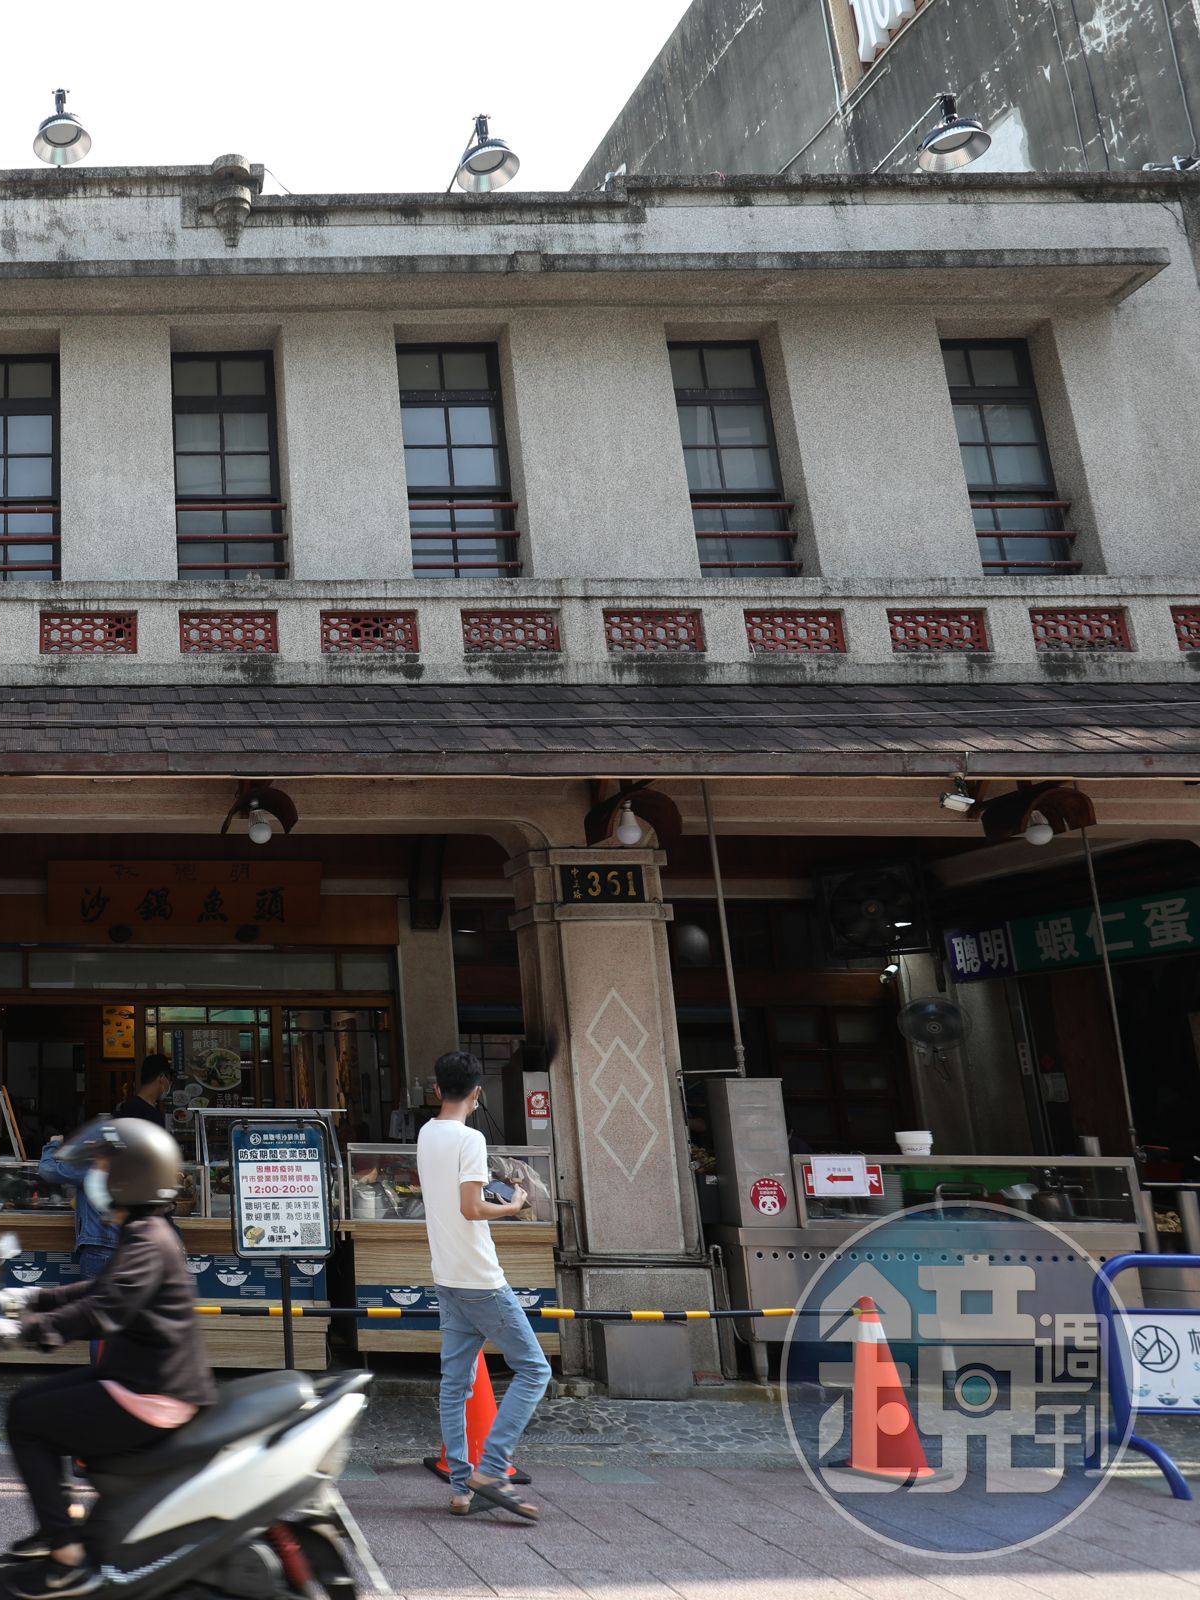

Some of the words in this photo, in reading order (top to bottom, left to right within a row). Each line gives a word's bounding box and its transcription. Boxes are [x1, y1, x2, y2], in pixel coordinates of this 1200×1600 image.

[80, 885, 287, 923] 沙鍋魚頭
[1034, 898, 1194, 961] 蝦仁蛋
[952, 928, 1009, 974] 聰明
[239, 1149, 318, 1160] 防疫期間營業時間
[248, 1185, 314, 1194] 12:00-20:00
